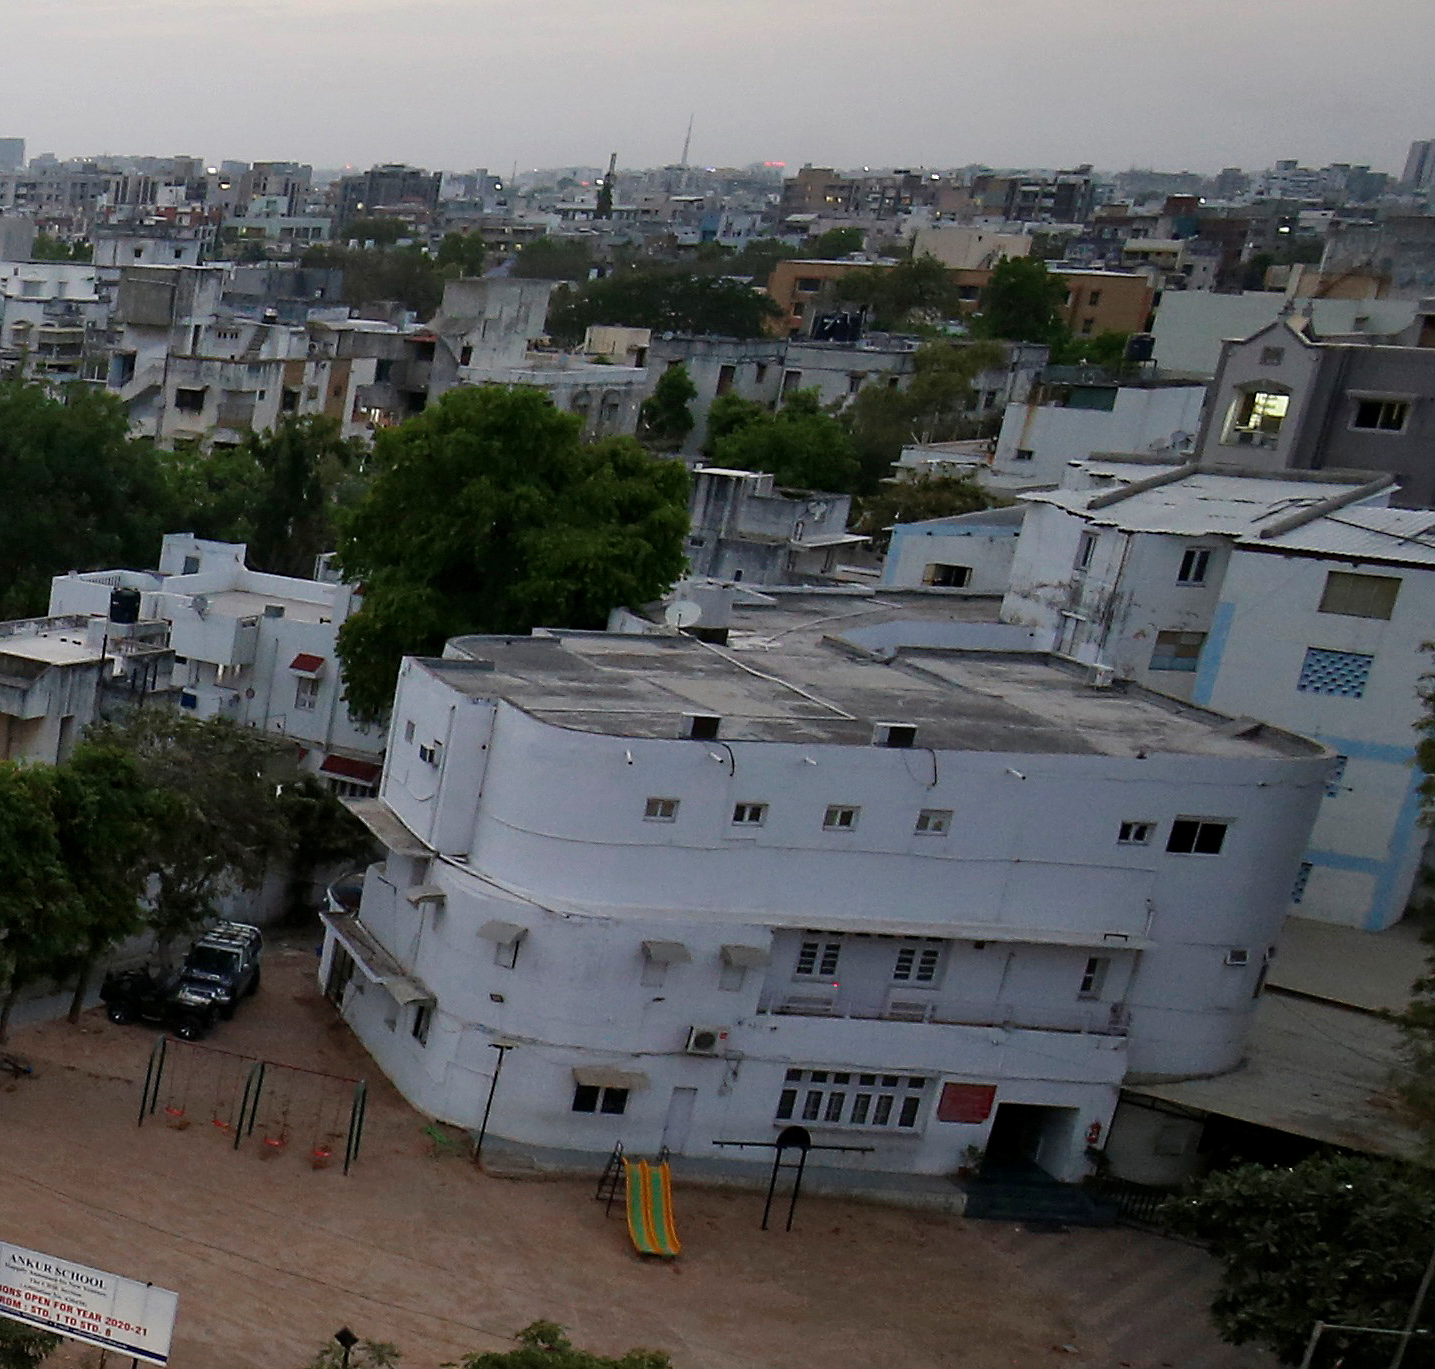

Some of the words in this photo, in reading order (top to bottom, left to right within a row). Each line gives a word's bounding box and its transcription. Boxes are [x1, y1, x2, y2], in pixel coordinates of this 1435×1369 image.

[10, 1254, 52, 1275] ANKUR
[55, 1266, 106, 1288] SCHOOL
[24, 1291, 51, 1307] OPEN
[53, 1300, 73, 1314] FOR
[76, 1308, 102, 1322] YEAR
[105, 1317, 148, 1337] 2020-21
[30, 1305, 52, 1319] STD.
[64, 1315, 77, 1326] TO
[79, 1320, 102, 1335] STD.
